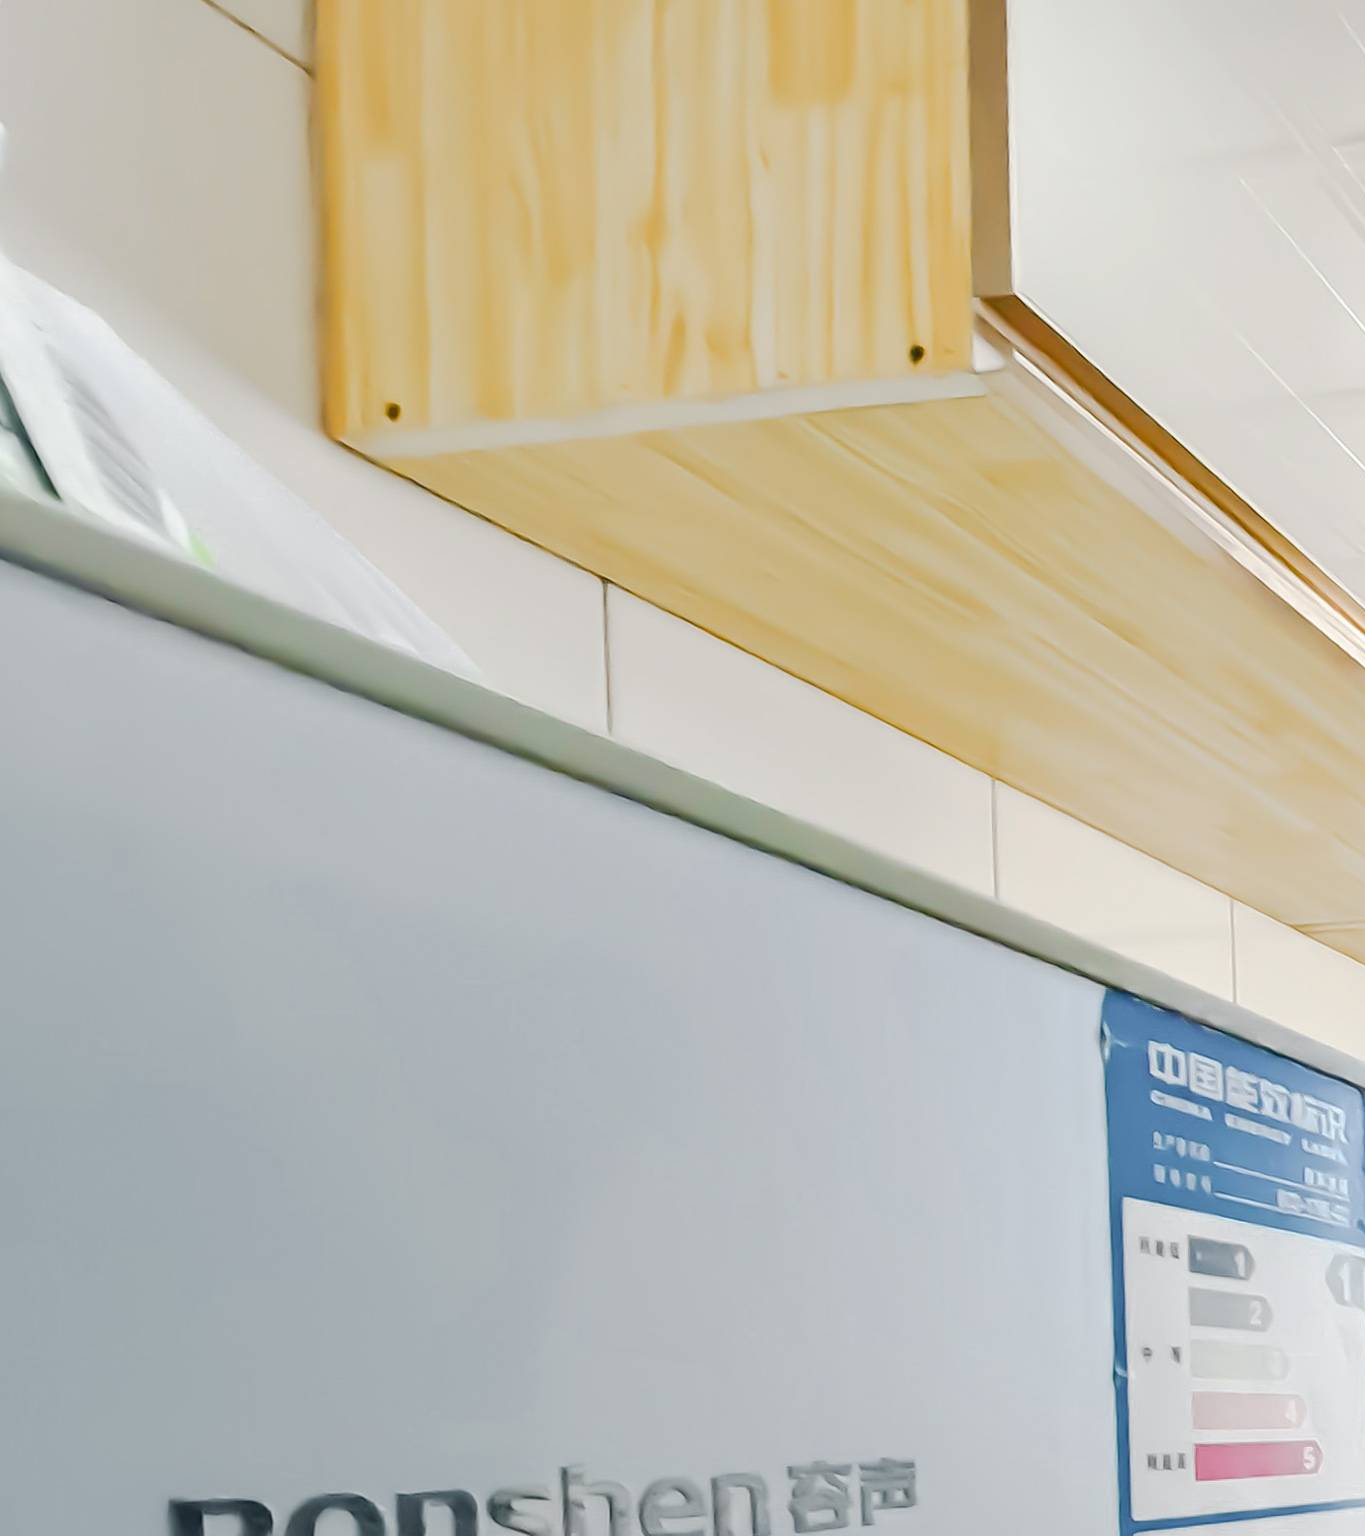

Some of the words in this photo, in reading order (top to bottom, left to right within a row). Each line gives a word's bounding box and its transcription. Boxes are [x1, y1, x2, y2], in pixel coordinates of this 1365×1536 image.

[1249, 1300, 1262, 1325] 2
[1303, 1446, 1316, 1471] 5
[785, 1456, 918, 1536] 容声
